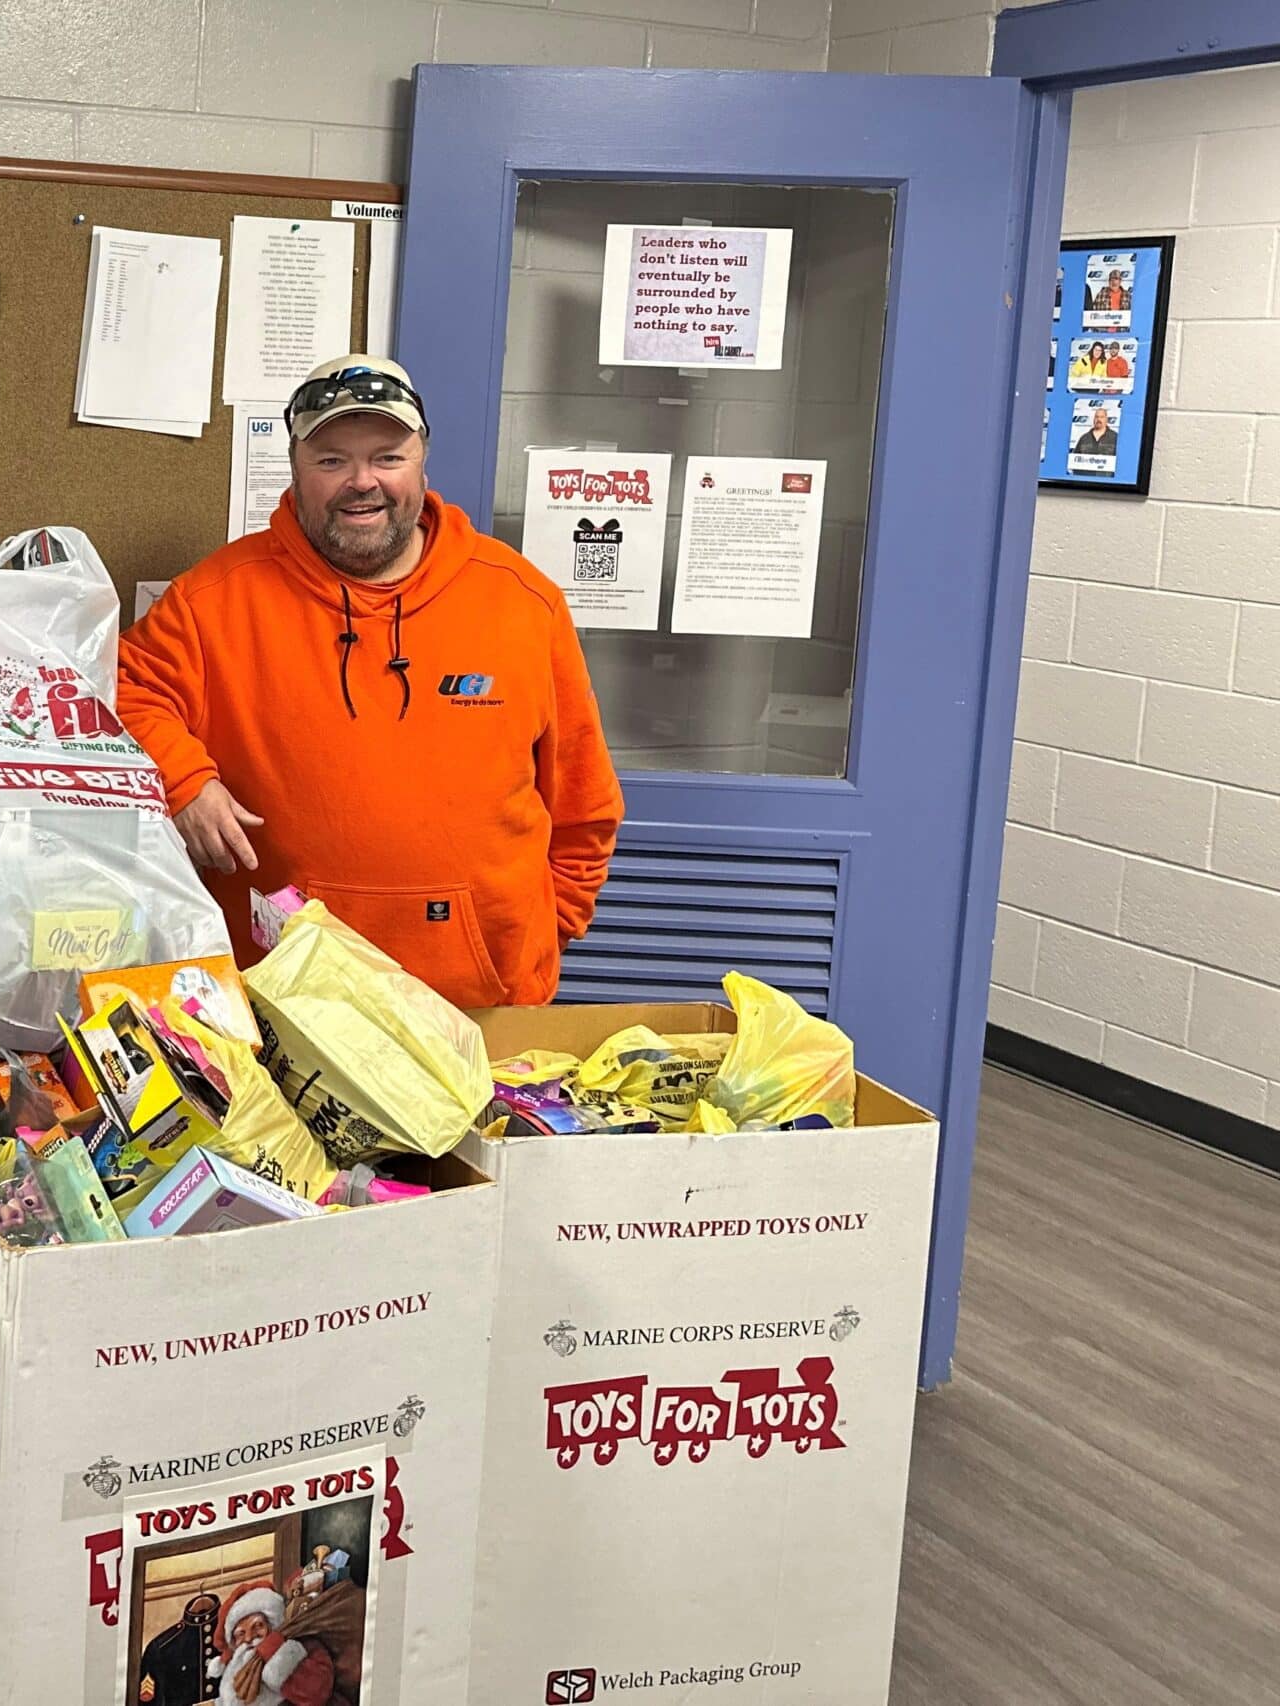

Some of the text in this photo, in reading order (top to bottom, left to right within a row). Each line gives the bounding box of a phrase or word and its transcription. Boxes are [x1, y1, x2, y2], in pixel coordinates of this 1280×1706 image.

[640, 236, 727, 250] Leaders who
[640, 252, 748, 267] don't listen will
[638, 270, 730, 284] eventually be
[636, 287, 736, 302] surrounded by
[635, 304, 750, 316] people who have
[634, 320, 738, 335] nothing to say.
[252, 422, 272, 433] UGI
[552, 474, 645, 496] TOYS FOR TOTS
[726, 487, 773, 497] GREETINGS!
[438, 673, 494, 696] UGI
[450, 698, 471, 706] Energy
[62, 741, 125, 754] GIFTING FOR
[48, 928, 92, 959] Mini
[684, 1061, 693, 1070] ON
[159, 1167, 206, 1219] ROCKSTAR
[557, 1212, 868, 1243] NEW, UNWRAPPED TOYS ONLY
[95, 1292, 433, 1369] NEW, UNWRAPPED TOYS ONLY
[582, 1319, 825, 1347] MARINE CORPS RESERVE
[552, 1389, 826, 1438] TOYS FOR TOTS
[128, 1414, 390, 1486] MARINE CORPS RESERVE
[136, 1466, 375, 1538] TOYS FOR TOTS
[600, 1660, 801, 1693] Welch Packaging Group
